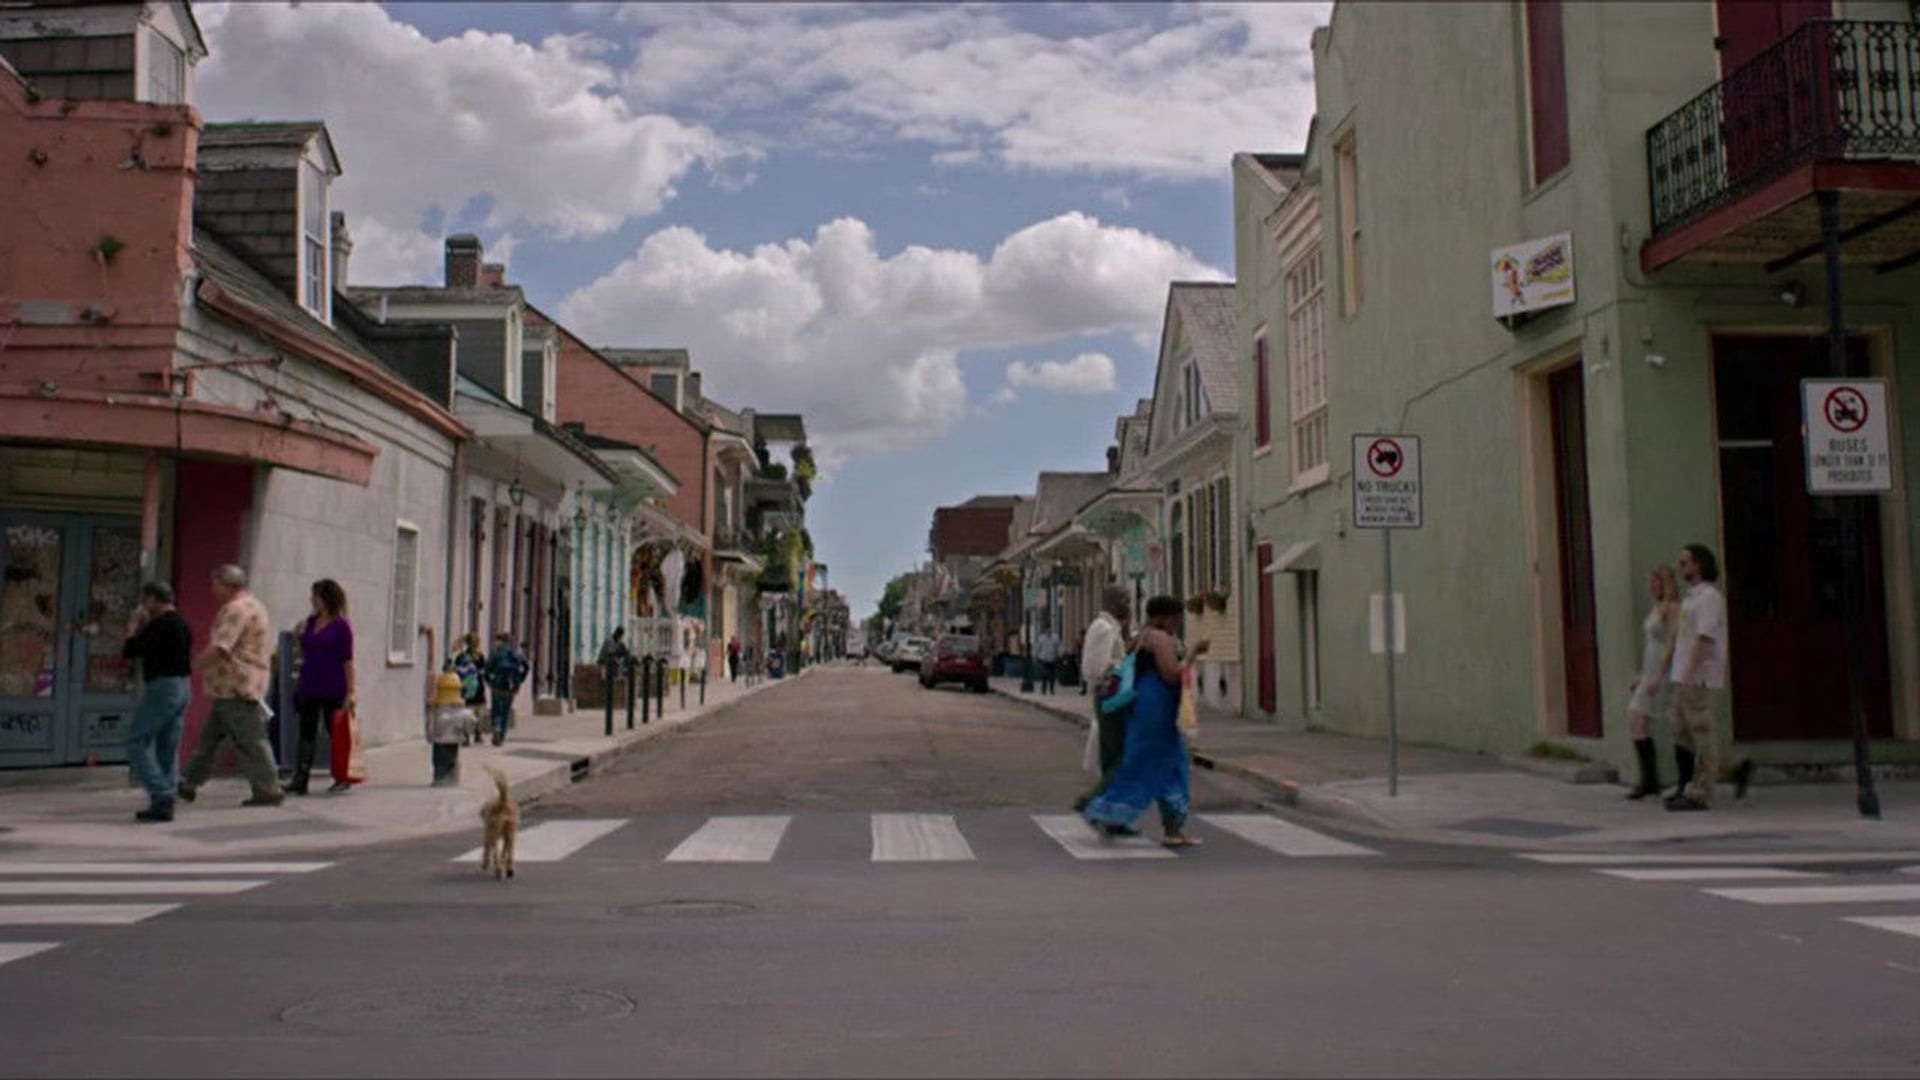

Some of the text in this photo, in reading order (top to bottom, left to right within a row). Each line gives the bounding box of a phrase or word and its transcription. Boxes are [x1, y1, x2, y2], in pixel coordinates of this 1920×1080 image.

[1829, 438, 1868, 452] BUSES
[1357, 481, 1416, 494] NO TRUCKS
